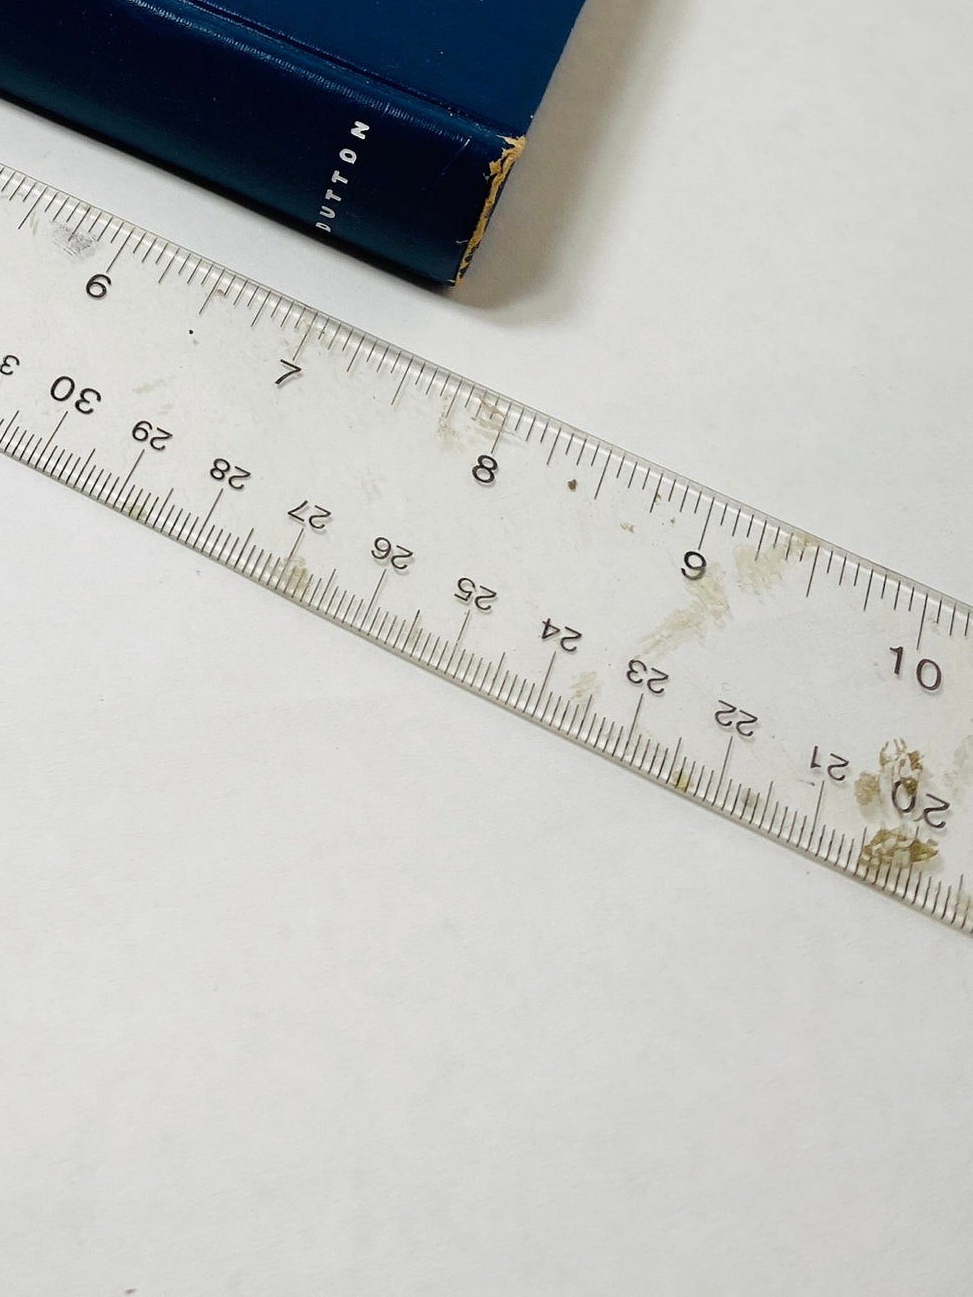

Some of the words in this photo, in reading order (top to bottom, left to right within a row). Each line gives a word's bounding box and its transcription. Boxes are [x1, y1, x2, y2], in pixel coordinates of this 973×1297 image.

[316, 121, 369, 232] DUTTON
[86, 274, 112, 298] 6
[275, 360, 302, 386] 7
[50, 376, 101, 415] 30
[132, 420, 173, 450] 29
[210, 458, 251, 490] 28
[472, 455, 498, 484] 8
[288, 501, 331, 530] 27
[371, 537, 414, 570] 26
[681, 551, 706, 579] 9
[454, 578, 497, 611] 25
[542, 618, 582, 652] 24
[627, 659, 670, 694] 23
[889, 645, 942, 691] 10
[715, 701, 758, 737] 22
[810, 747, 849, 781] 21
[892, 780, 951, 828] 20
